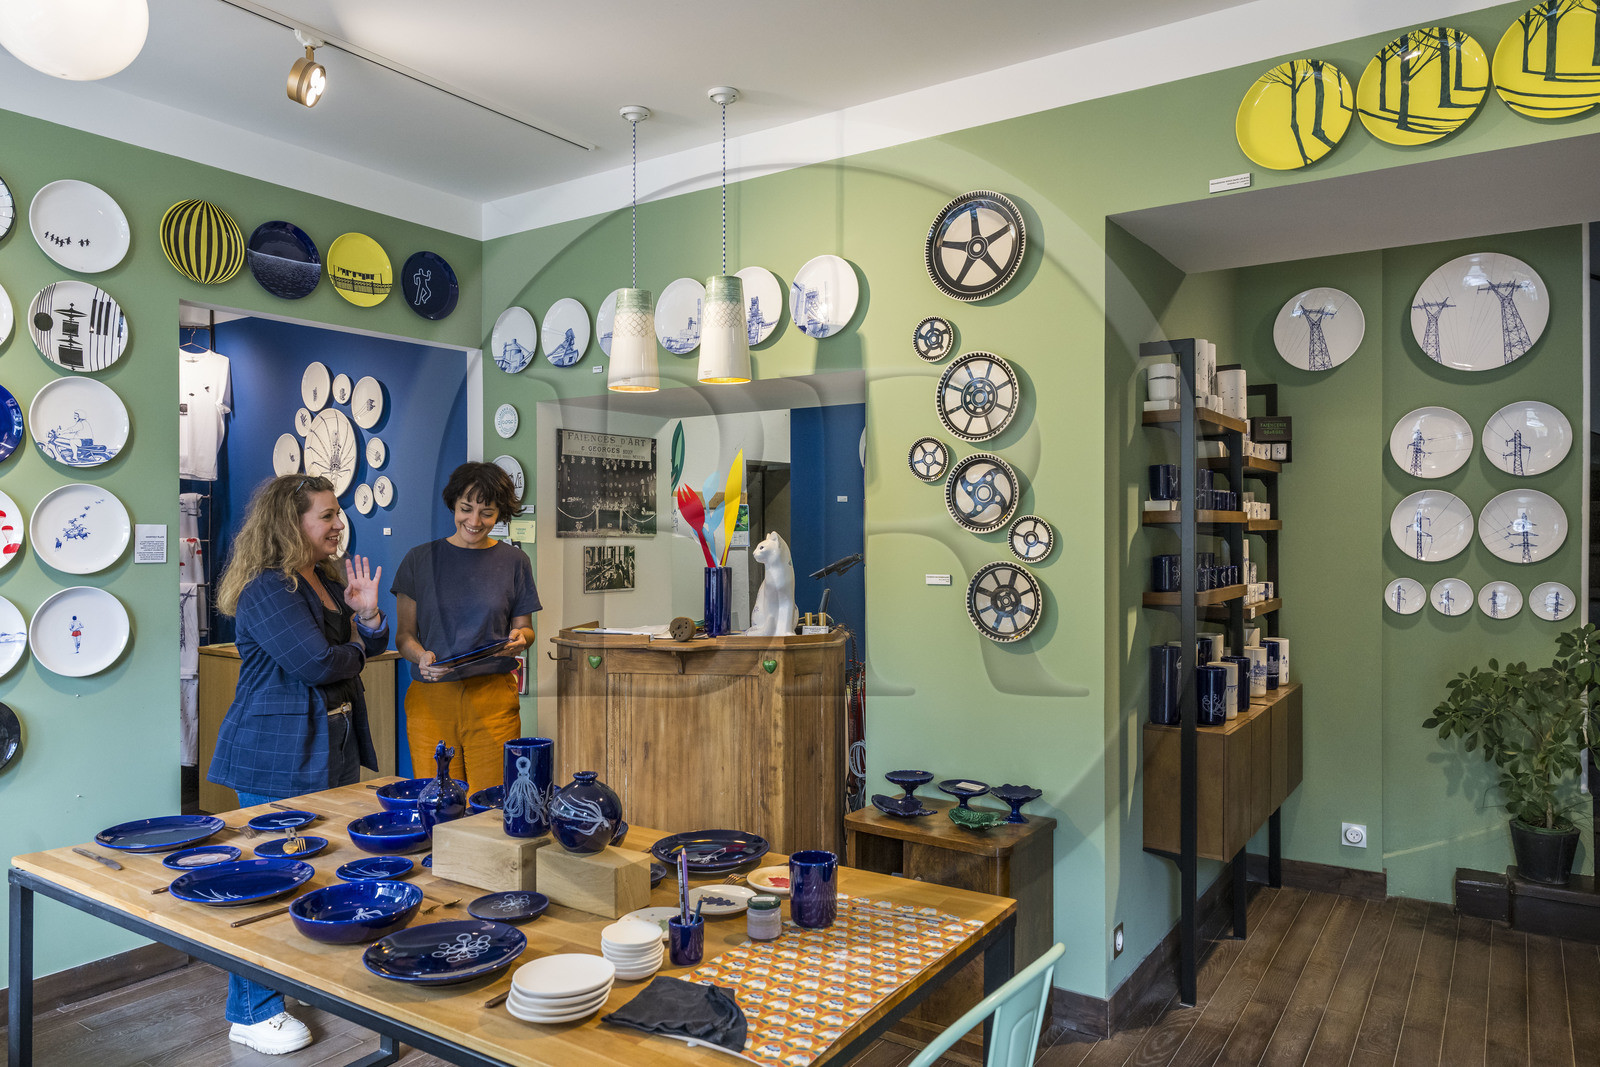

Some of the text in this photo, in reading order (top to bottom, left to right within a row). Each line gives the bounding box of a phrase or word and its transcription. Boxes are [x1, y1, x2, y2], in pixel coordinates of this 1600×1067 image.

[568, 432, 616, 444] FAIENCES
[621, 438, 647, 447] D'ART
[588, 445, 620, 454] GEORGES
